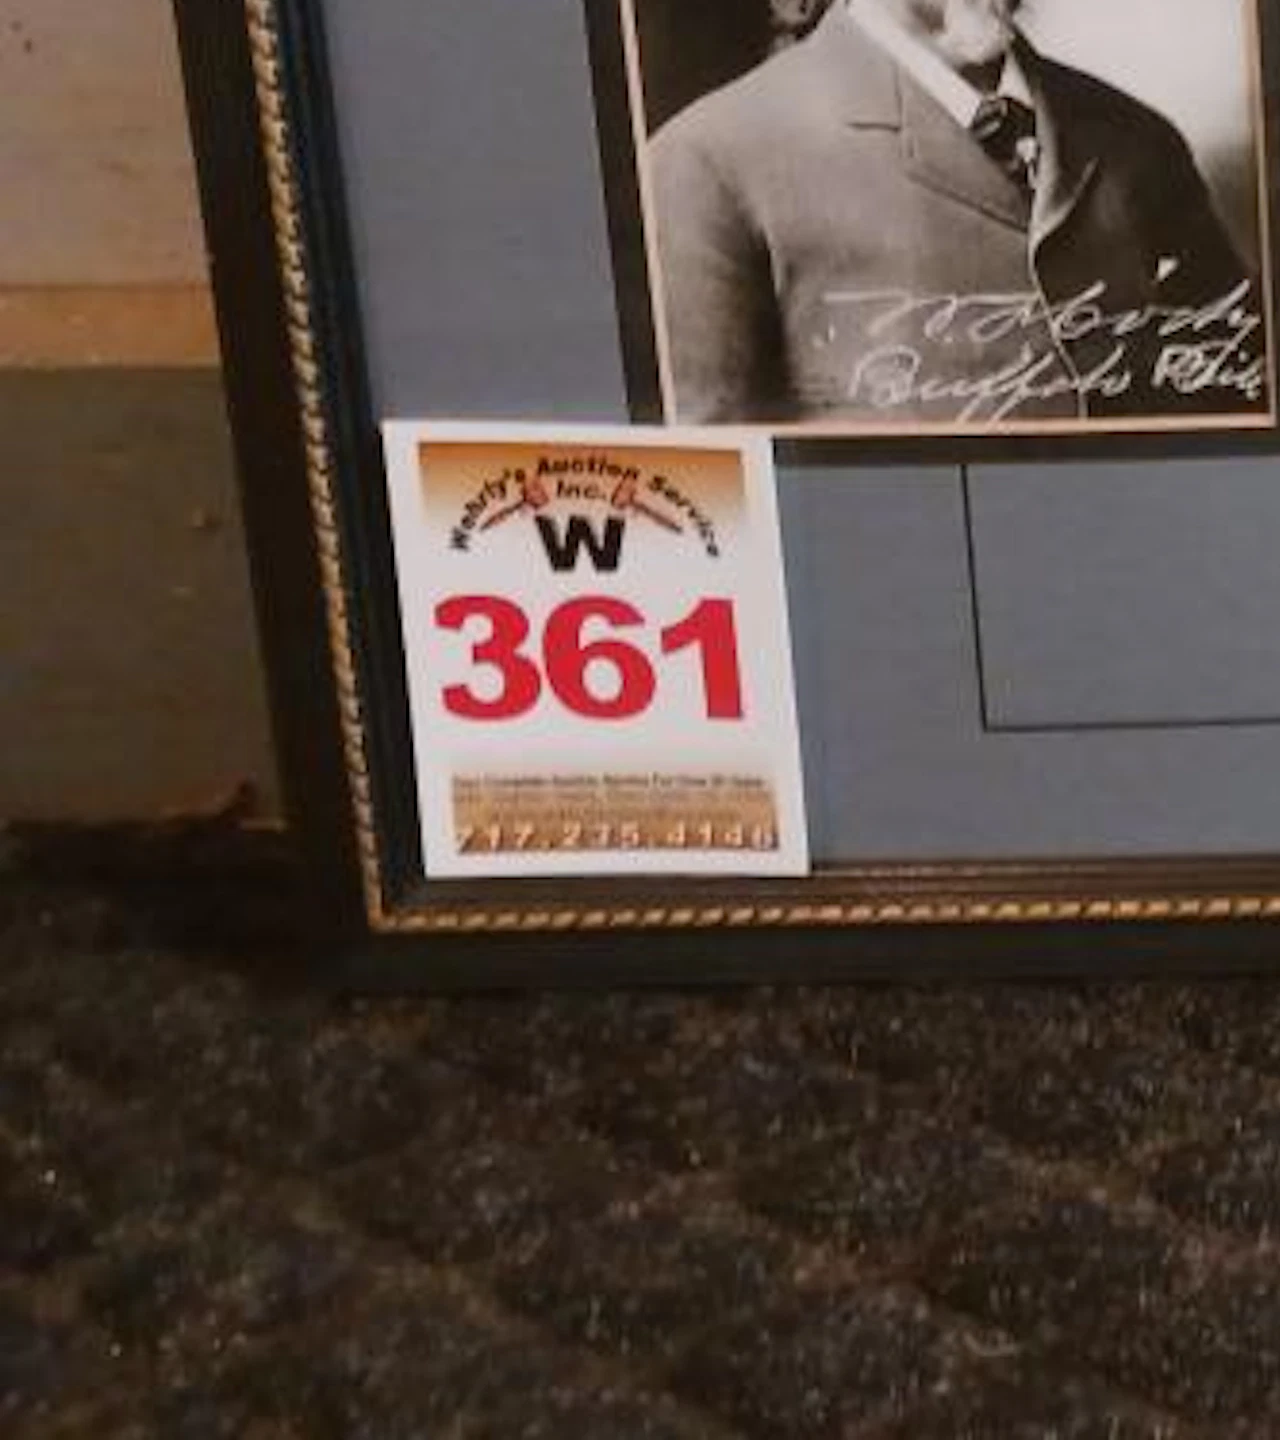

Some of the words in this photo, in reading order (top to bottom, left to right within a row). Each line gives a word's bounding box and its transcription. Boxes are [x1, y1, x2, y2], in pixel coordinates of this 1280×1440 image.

[537, 455, 641, 480] Auction
[556, 479, 608, 502] Inc.
[535, 515, 626, 572] W
[433, 593, 745, 722] 361
